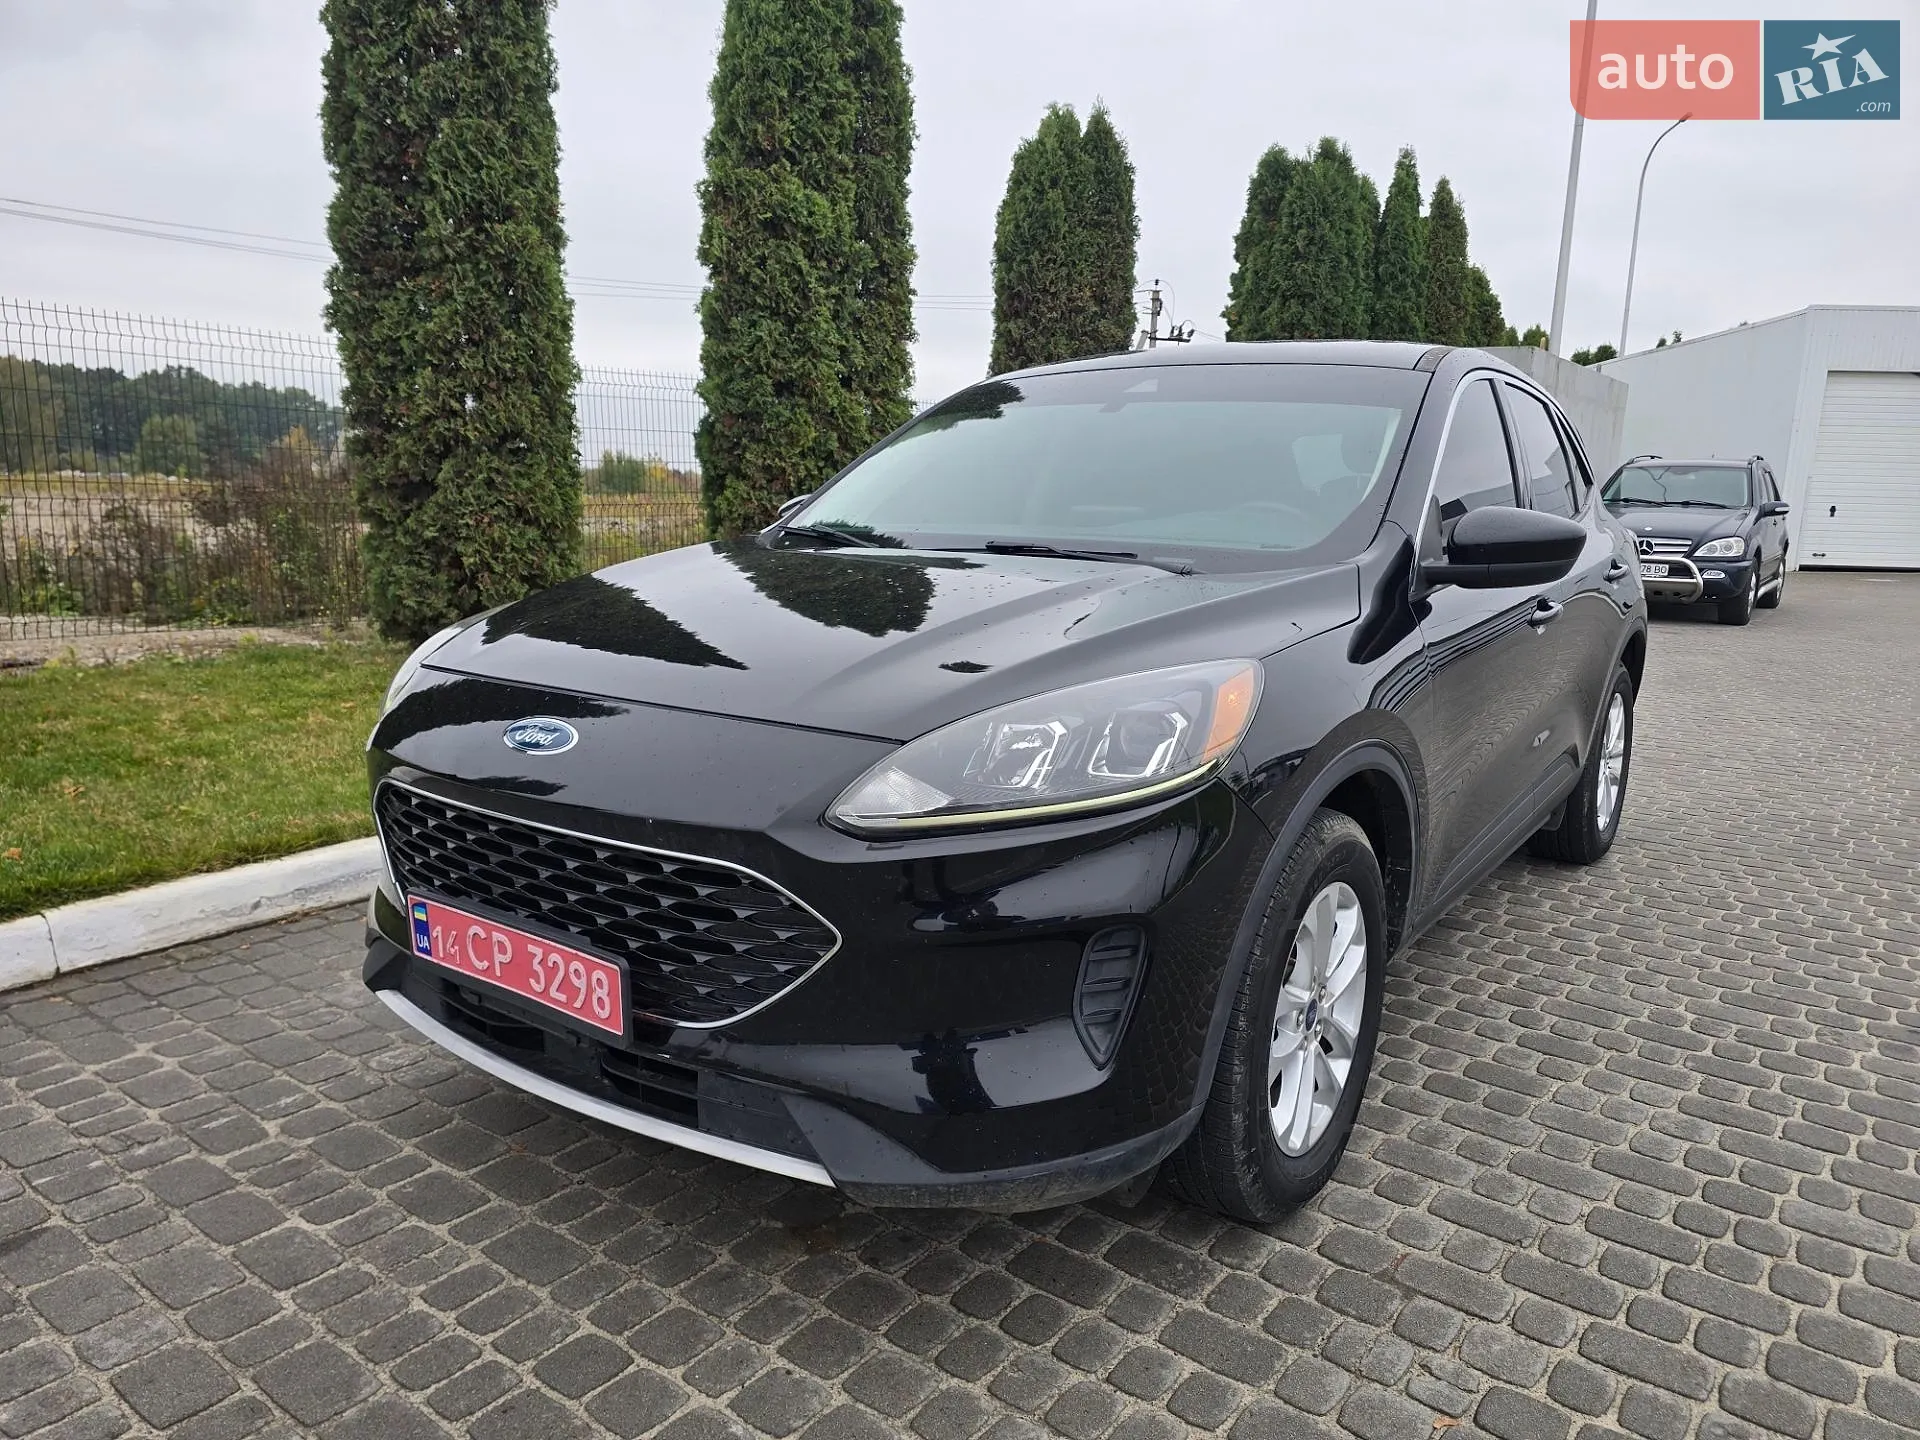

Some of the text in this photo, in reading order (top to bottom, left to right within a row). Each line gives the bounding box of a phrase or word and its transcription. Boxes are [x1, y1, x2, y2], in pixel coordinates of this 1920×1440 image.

[515, 723, 560, 746] Ford
[416, 933, 431, 950] UA
[527, 944, 612, 1020] 3298
